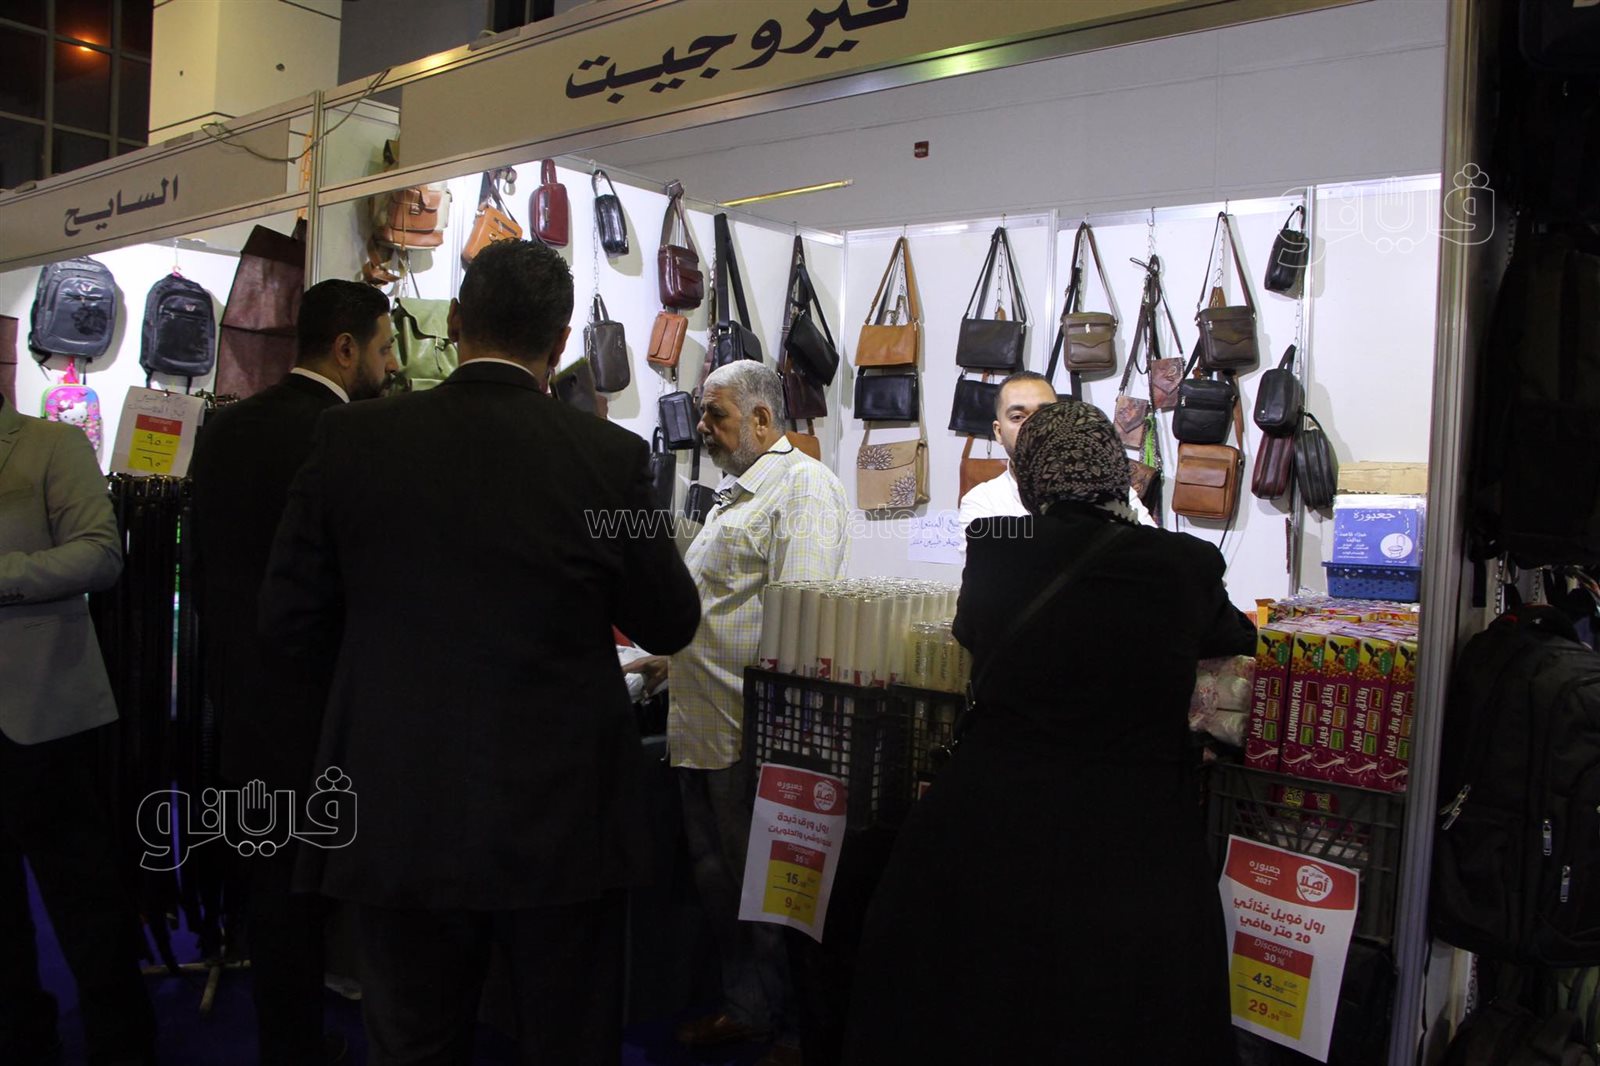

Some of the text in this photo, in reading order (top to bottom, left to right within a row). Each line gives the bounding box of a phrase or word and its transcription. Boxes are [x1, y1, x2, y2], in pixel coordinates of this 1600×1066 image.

[64, 174, 178, 236] السايح
[1253, 702, 1265, 717] ورق
[1287, 680, 1304, 743] ALUMINUM FOIL
[1320, 709, 1332, 725] ورق
[1353, 713, 1366, 729] ورق
[1388, 717, 1401, 733] ورق
[798, 818, 815, 831] ورق
[1249, 860, 1281, 875] جعبوره
[1255, 876, 1272, 885] 2021
[1233, 896, 1325, 935] رول فويل غذائي
[1240, 915, 1310, 944] 20 متر صافي
[1254, 939, 1293, 958] Discount
